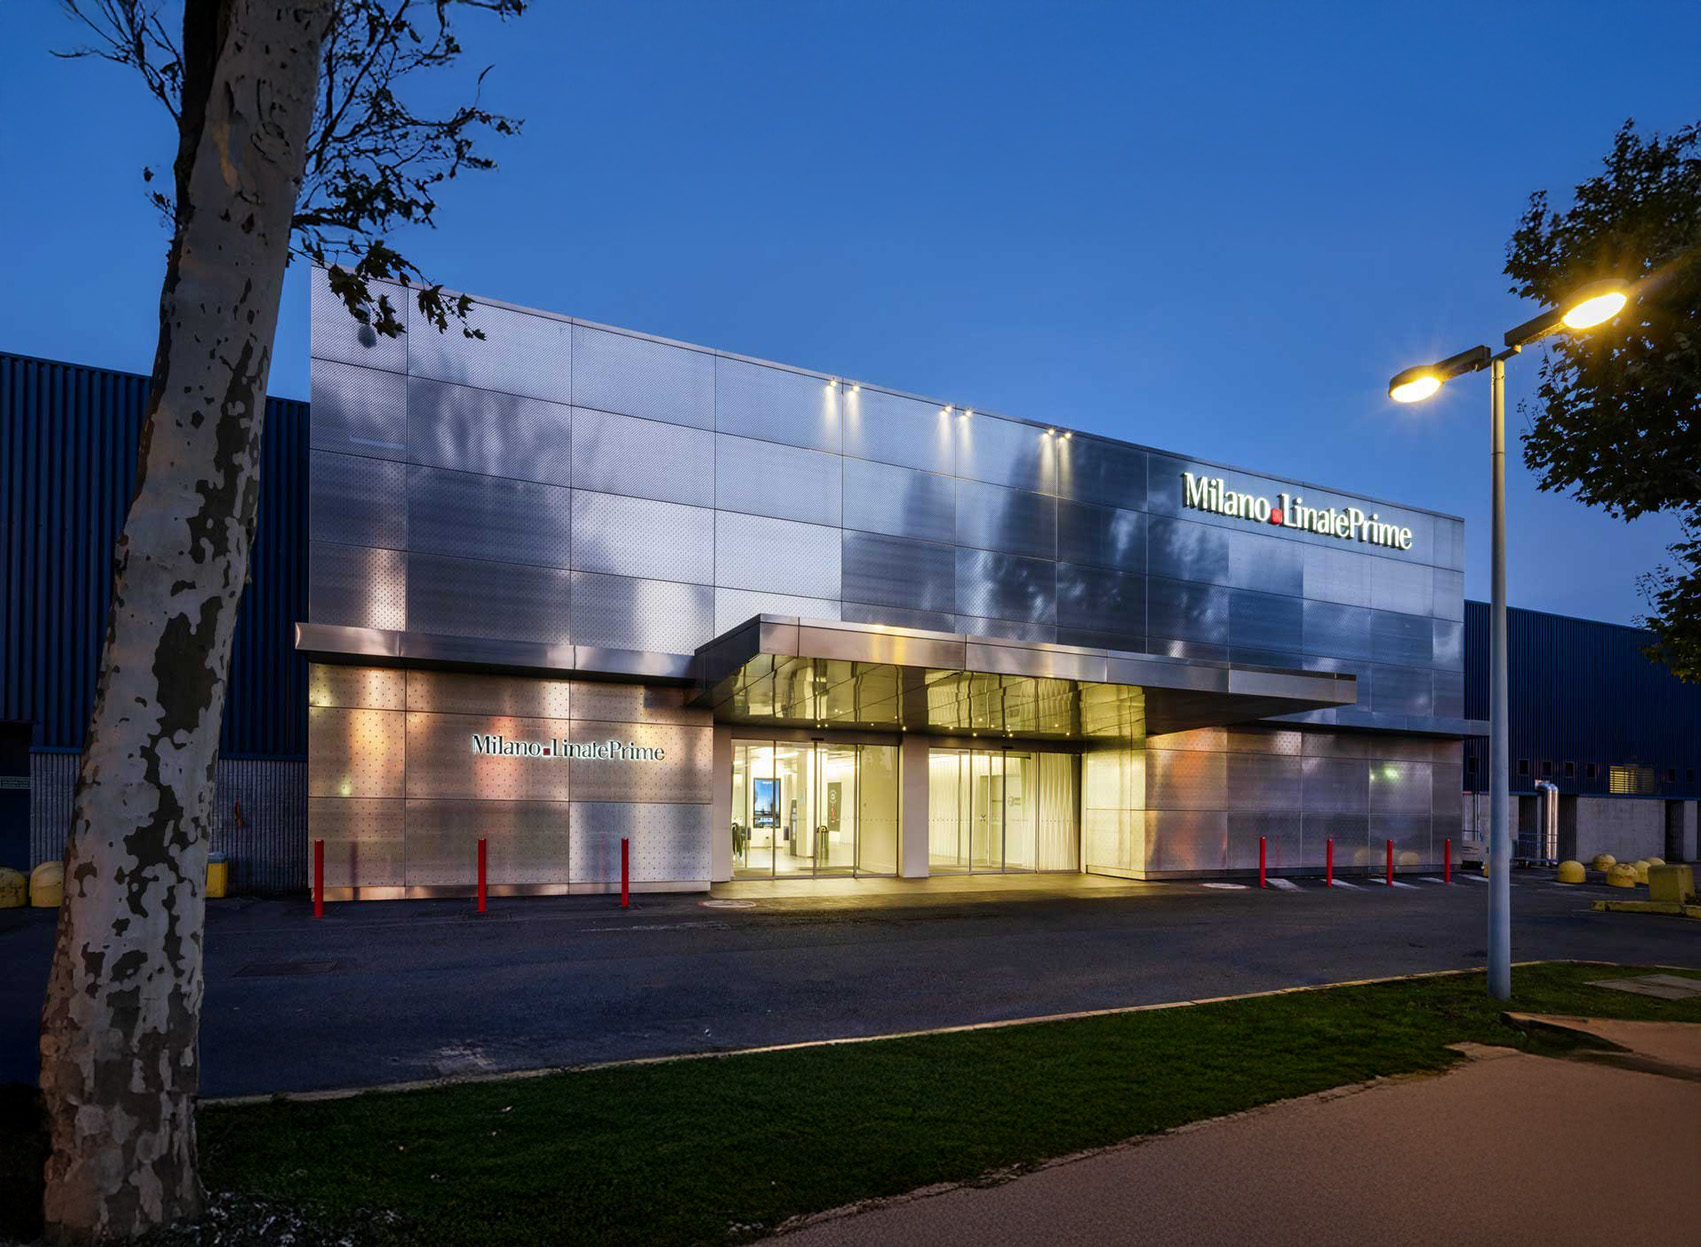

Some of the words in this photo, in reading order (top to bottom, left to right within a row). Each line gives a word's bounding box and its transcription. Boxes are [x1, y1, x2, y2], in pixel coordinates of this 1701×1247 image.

[1183, 472, 1271, 522] Milano
[1278, 493, 1413, 550] LinatePrime
[472, 734, 541, 757] Milano
[551, 738, 666, 762] LinatePrime
